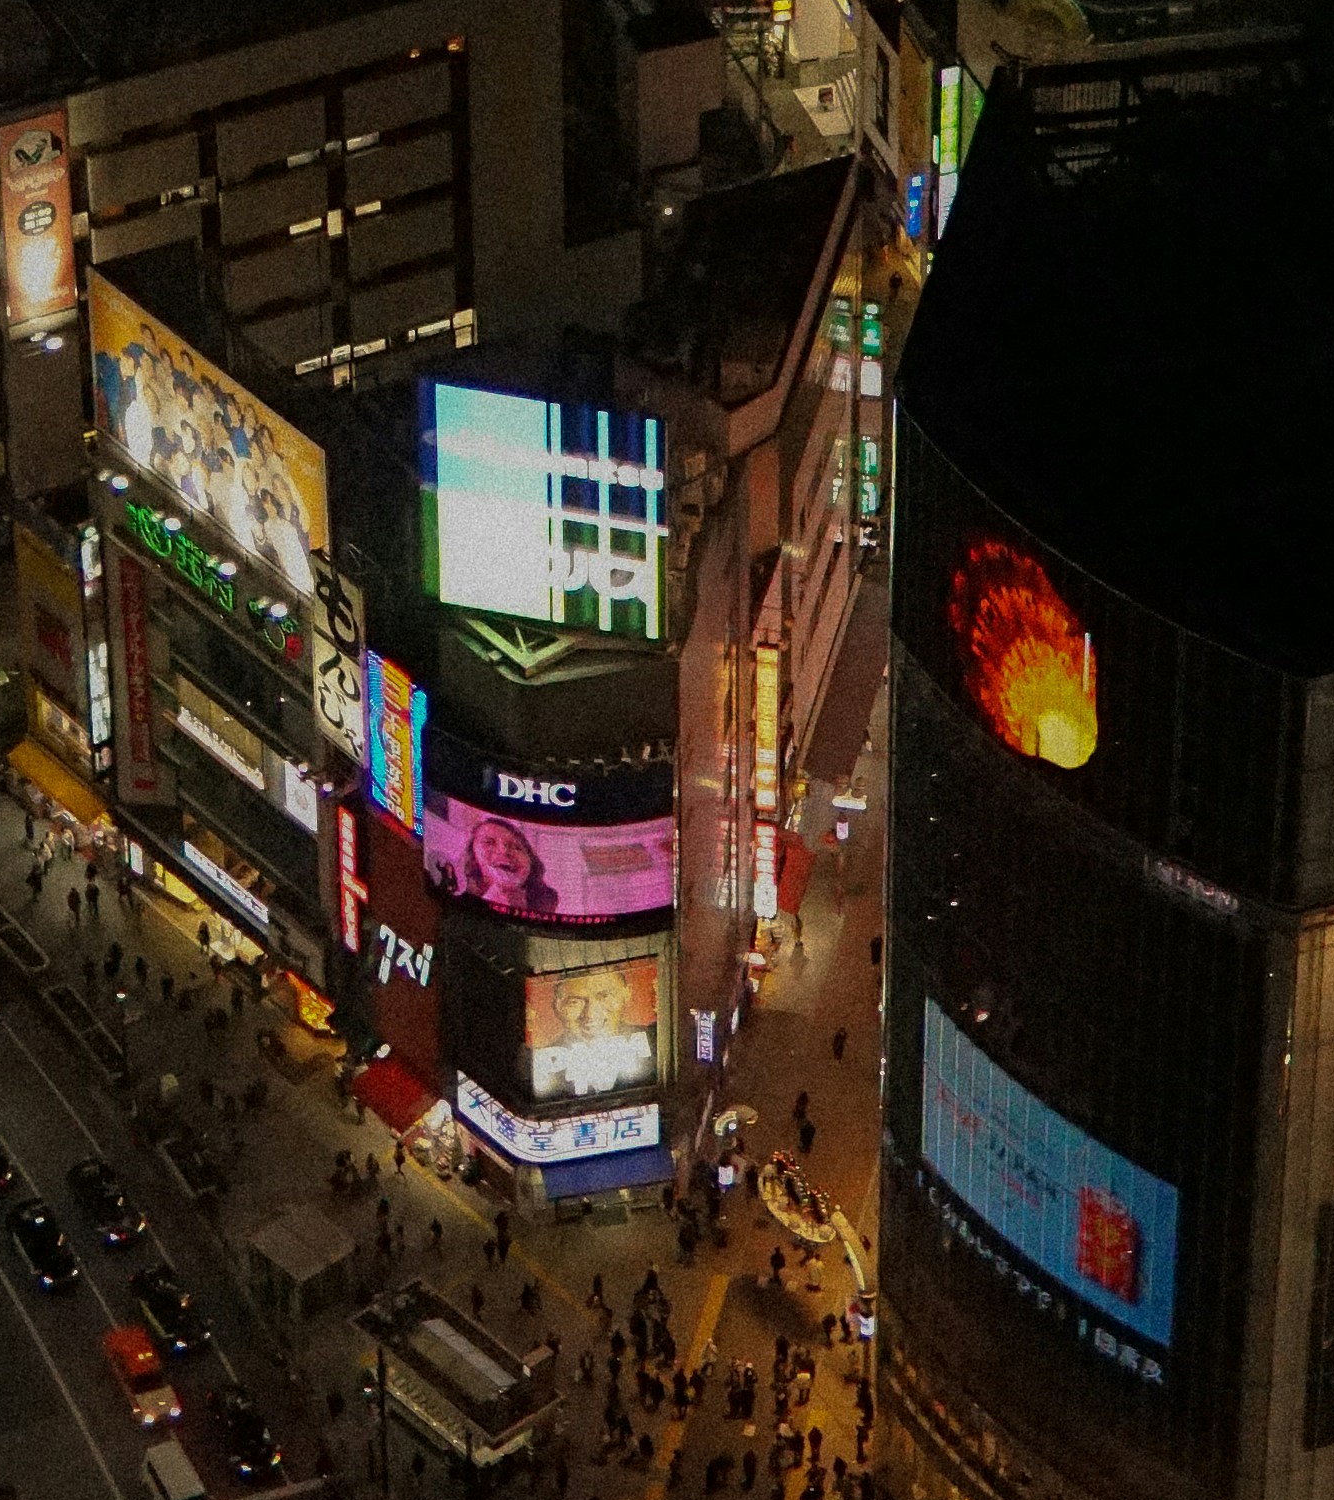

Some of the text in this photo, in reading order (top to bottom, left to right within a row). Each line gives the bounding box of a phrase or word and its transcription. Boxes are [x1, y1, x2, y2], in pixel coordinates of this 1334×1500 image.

[498, 773, 578, 808] DHC
[378, 923, 434, 987] クスリ
